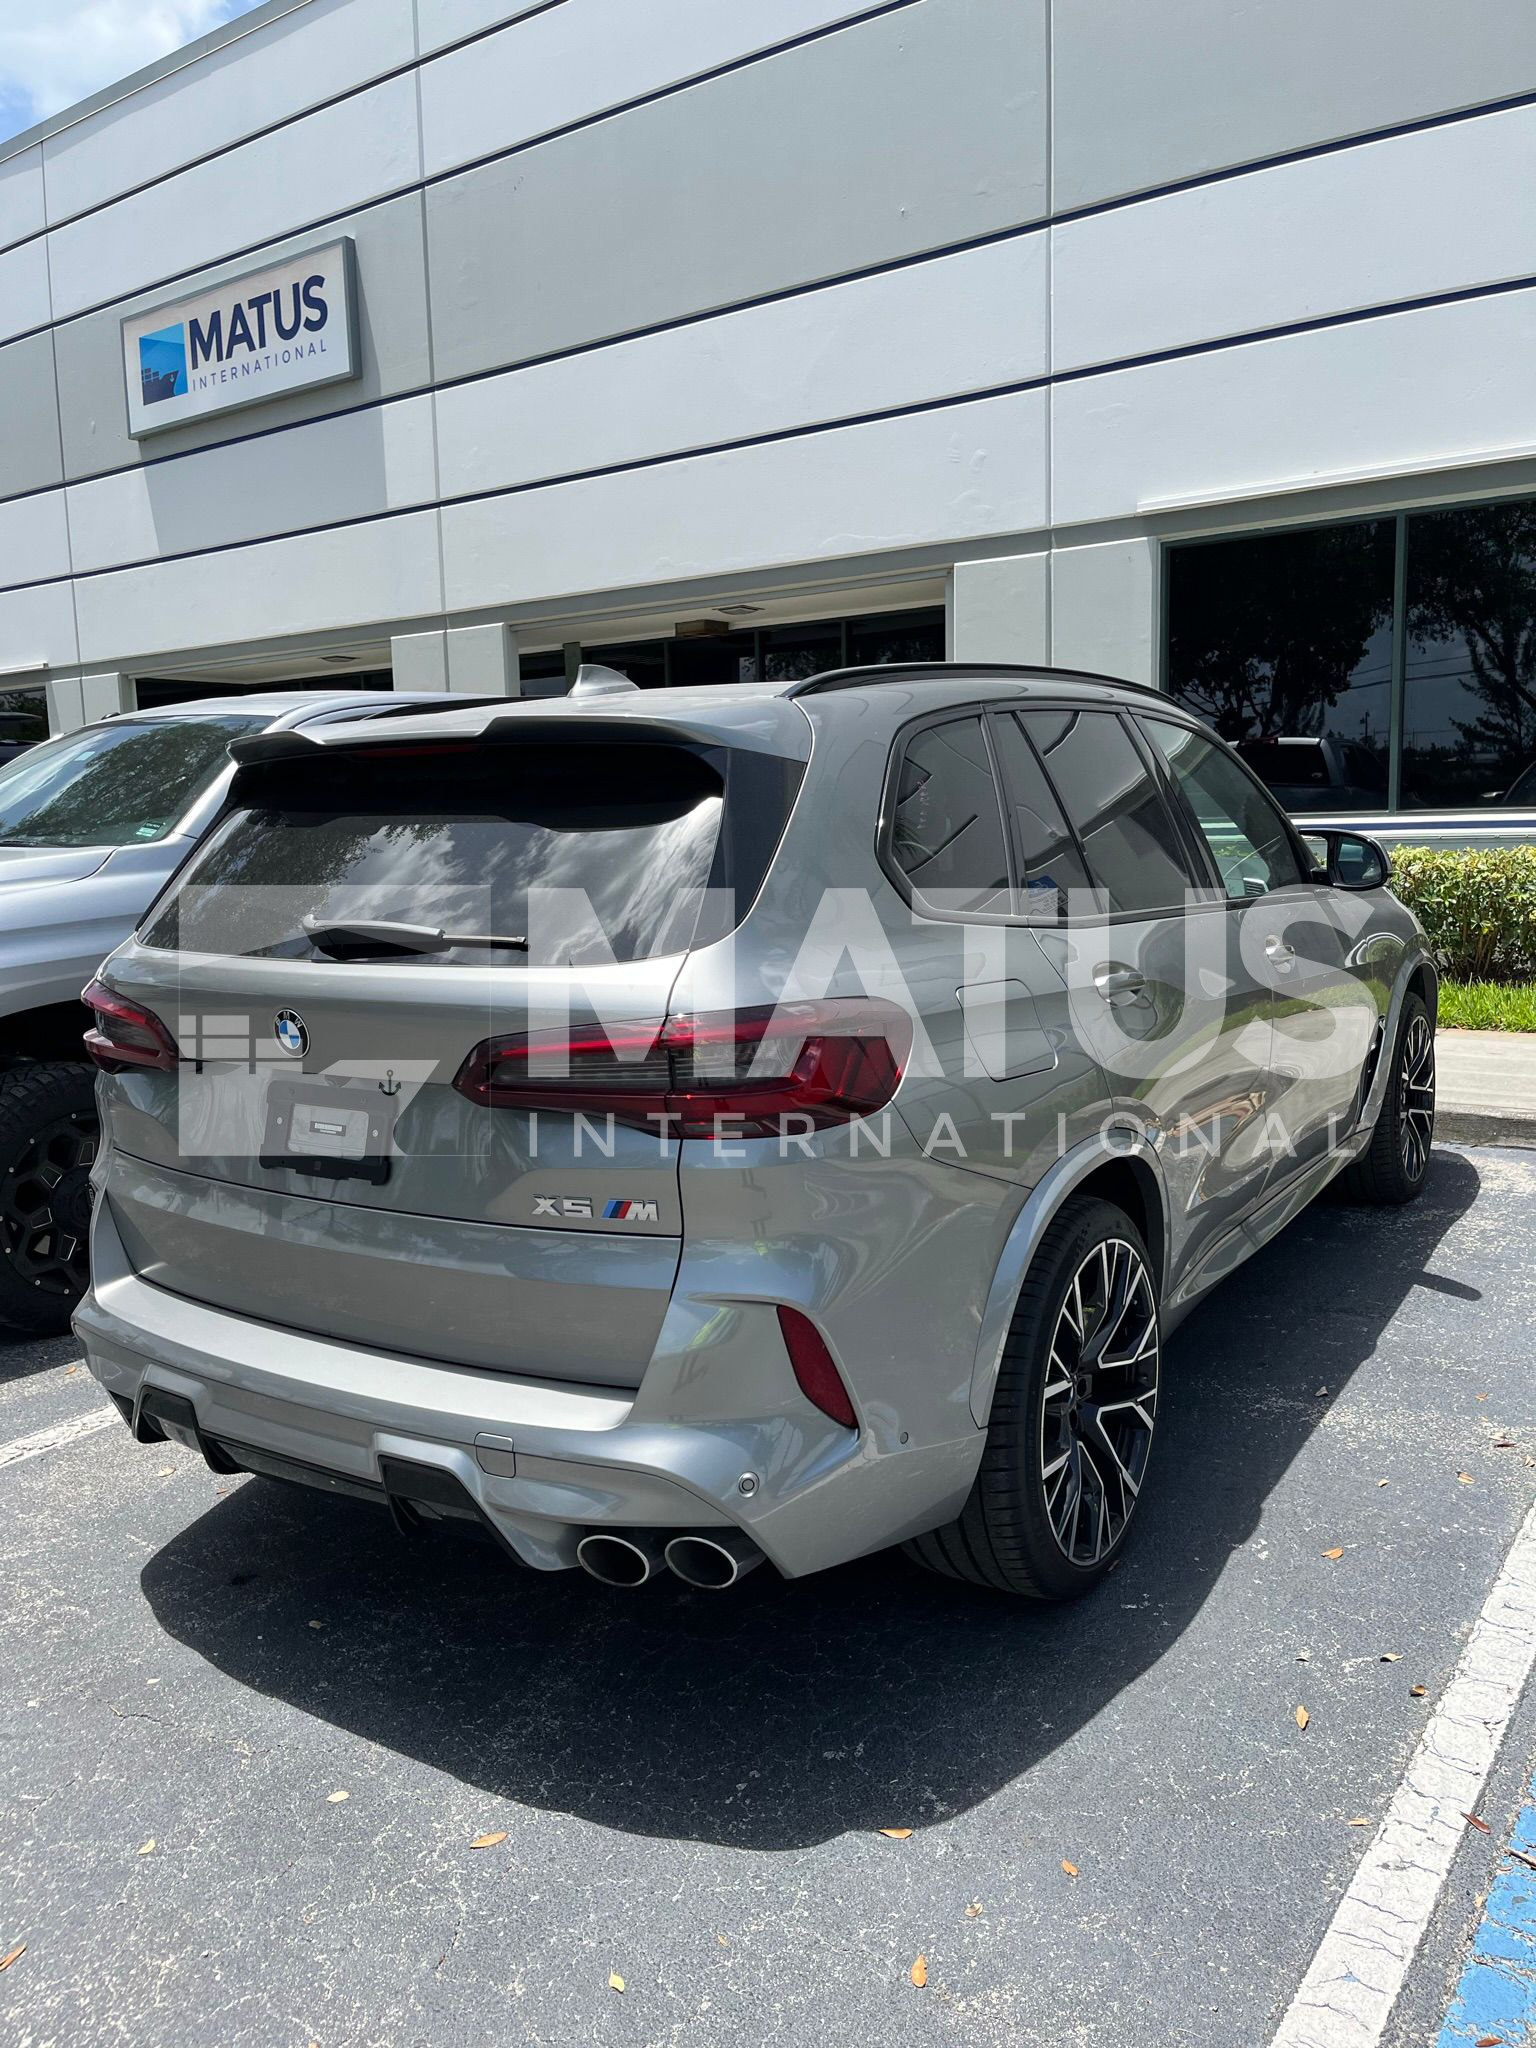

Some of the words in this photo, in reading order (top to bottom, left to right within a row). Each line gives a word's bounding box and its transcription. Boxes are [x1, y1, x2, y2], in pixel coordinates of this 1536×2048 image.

[189, 275, 328, 371] MATUS
[192, 339, 328, 392] INTERNATIONAL
[530, 1194, 593, 1219] X5
